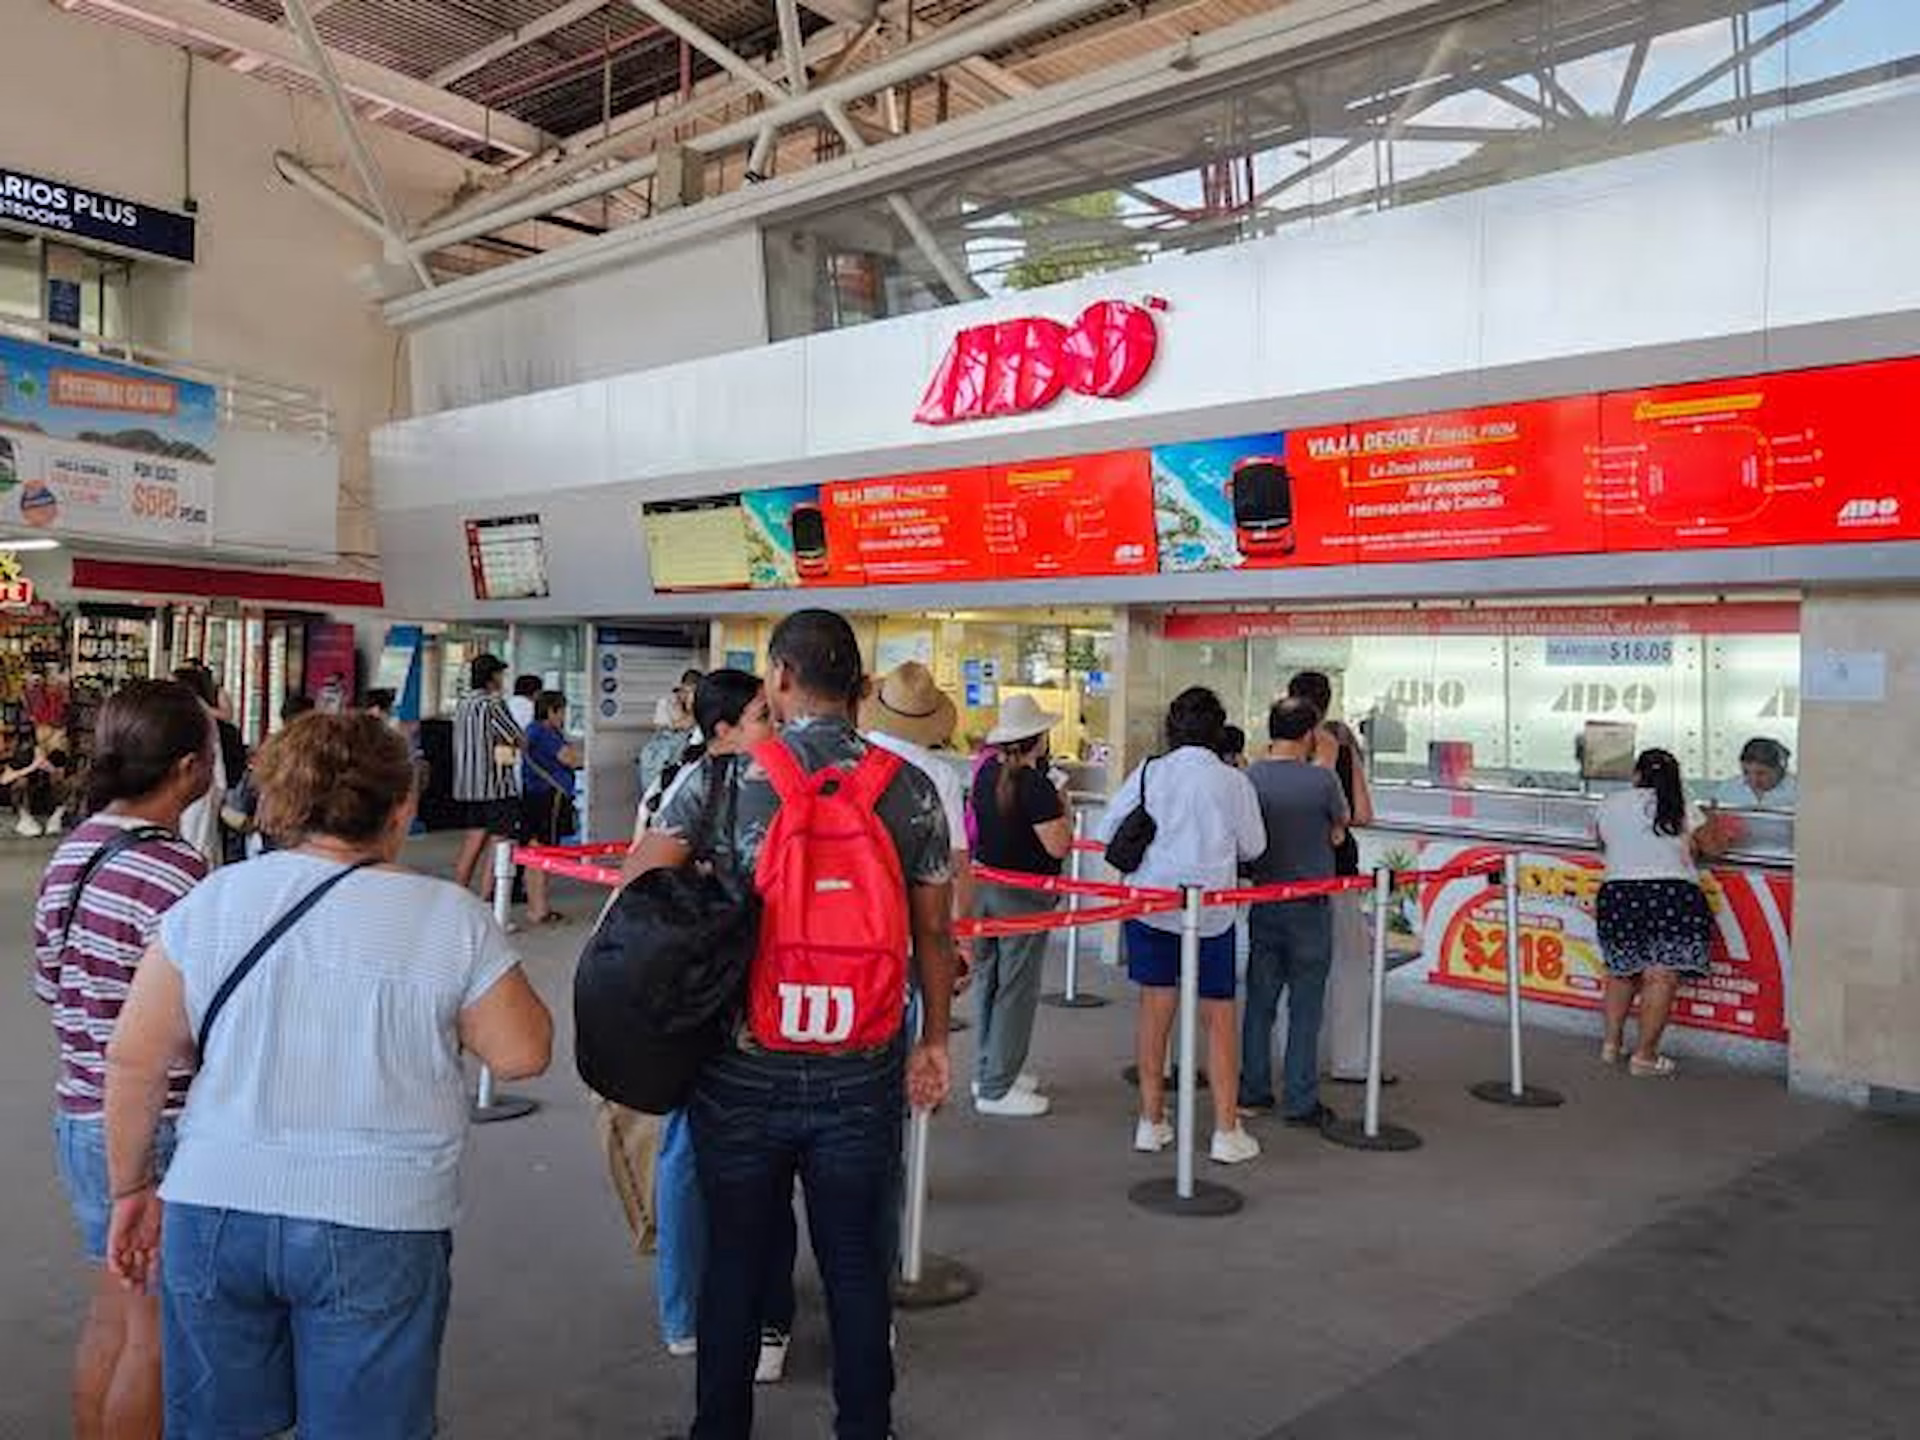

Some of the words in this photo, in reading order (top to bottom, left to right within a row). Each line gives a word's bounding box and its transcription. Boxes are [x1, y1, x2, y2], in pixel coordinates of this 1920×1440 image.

[0, 175, 69, 210] RIOS
[73, 193, 138, 227] PLUS
[912, 300, 1158, 426] ADO
[1306, 431, 1361, 458] VIAJA
[1363, 426, 1421, 451] DESDE
[1369, 463, 1385, 479] La
[1838, 496, 1899, 519] ADO
[1550, 682, 1657, 714] ADO
[1461, 923, 1564, 982] $218
